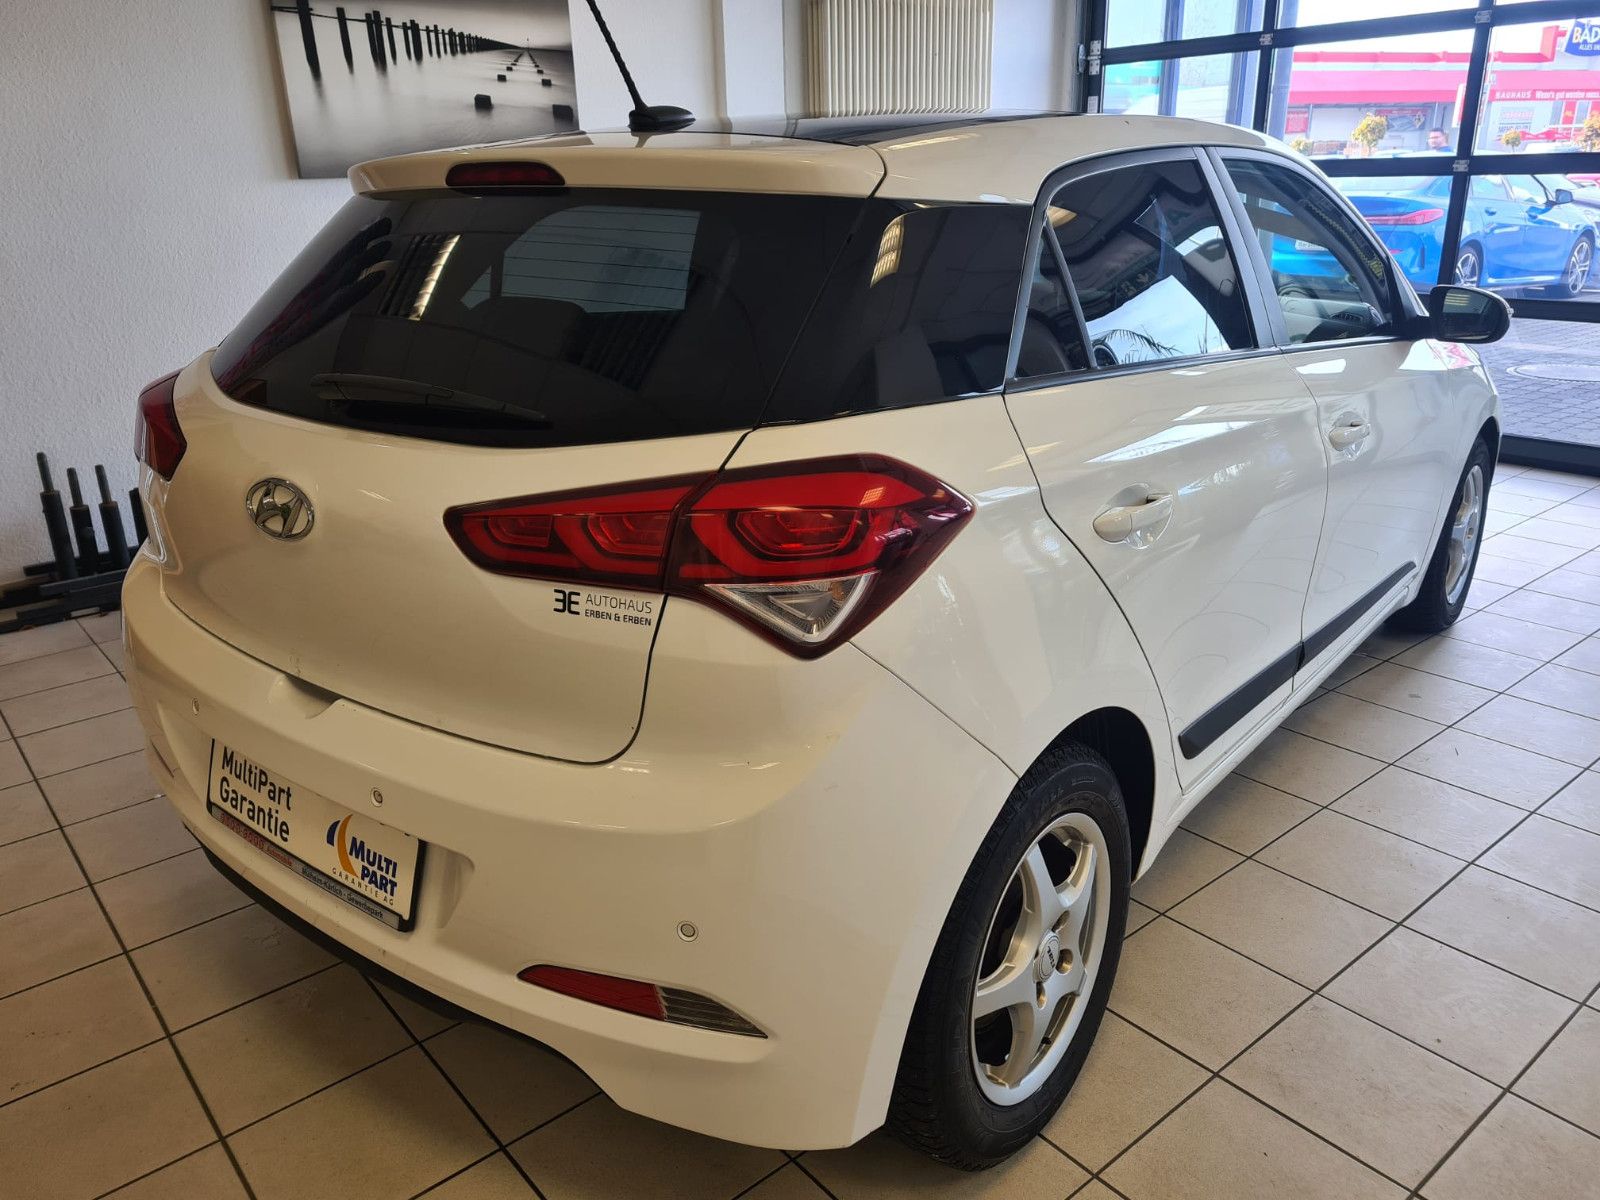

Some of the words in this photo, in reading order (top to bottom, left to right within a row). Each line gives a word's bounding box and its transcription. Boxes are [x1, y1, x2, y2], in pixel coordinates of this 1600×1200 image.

[585, 593, 652, 614] AUTOHAUS
[585, 609, 612, 620] ERBEN
[614, 613, 620, 622] &
[623, 614, 652, 626] ERBEN
[222, 746, 292, 811] MultiPart
[220, 776, 290, 842] Garantie
[349, 836, 398, 878] MULTI
[332, 867, 378, 897] GARANTIE
[384, 895, 394, 905] AG
[361, 865, 397, 896] PART
